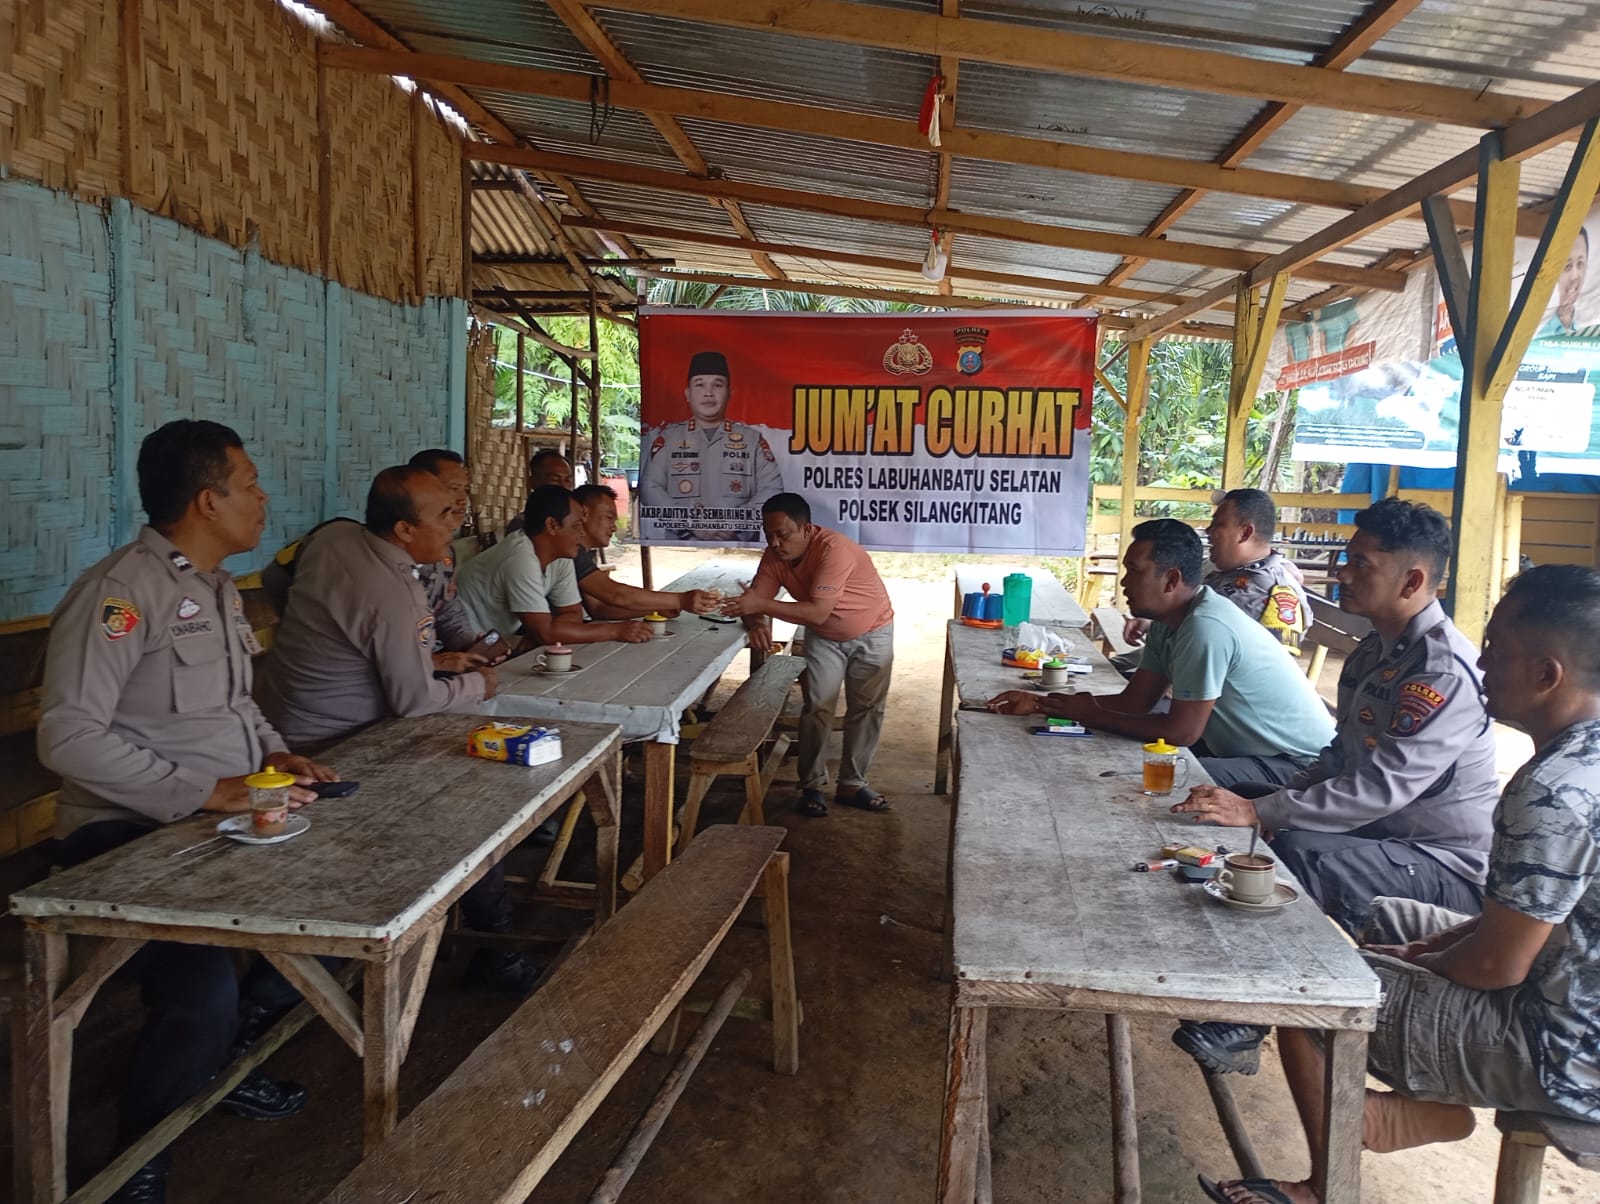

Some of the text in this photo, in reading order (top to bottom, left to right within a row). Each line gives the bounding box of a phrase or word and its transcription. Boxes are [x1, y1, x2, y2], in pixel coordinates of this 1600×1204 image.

[790, 386, 1081, 458] JUM'AT CURHAT
[722, 451, 750, 459] POLRI
[803, 466, 1061, 494] POLRES LABUHANBATU SELATAN
[641, 507, 660, 519] AKBP
[663, 507, 688, 519] ADITYA
[703, 508, 744, 521] SEMBIRING
[839, 500, 1022, 525] POLSEK SILANGKITANG
[653, 521, 686, 529] KAPOLRES
[688, 522, 733, 530] LABUHANBATU
